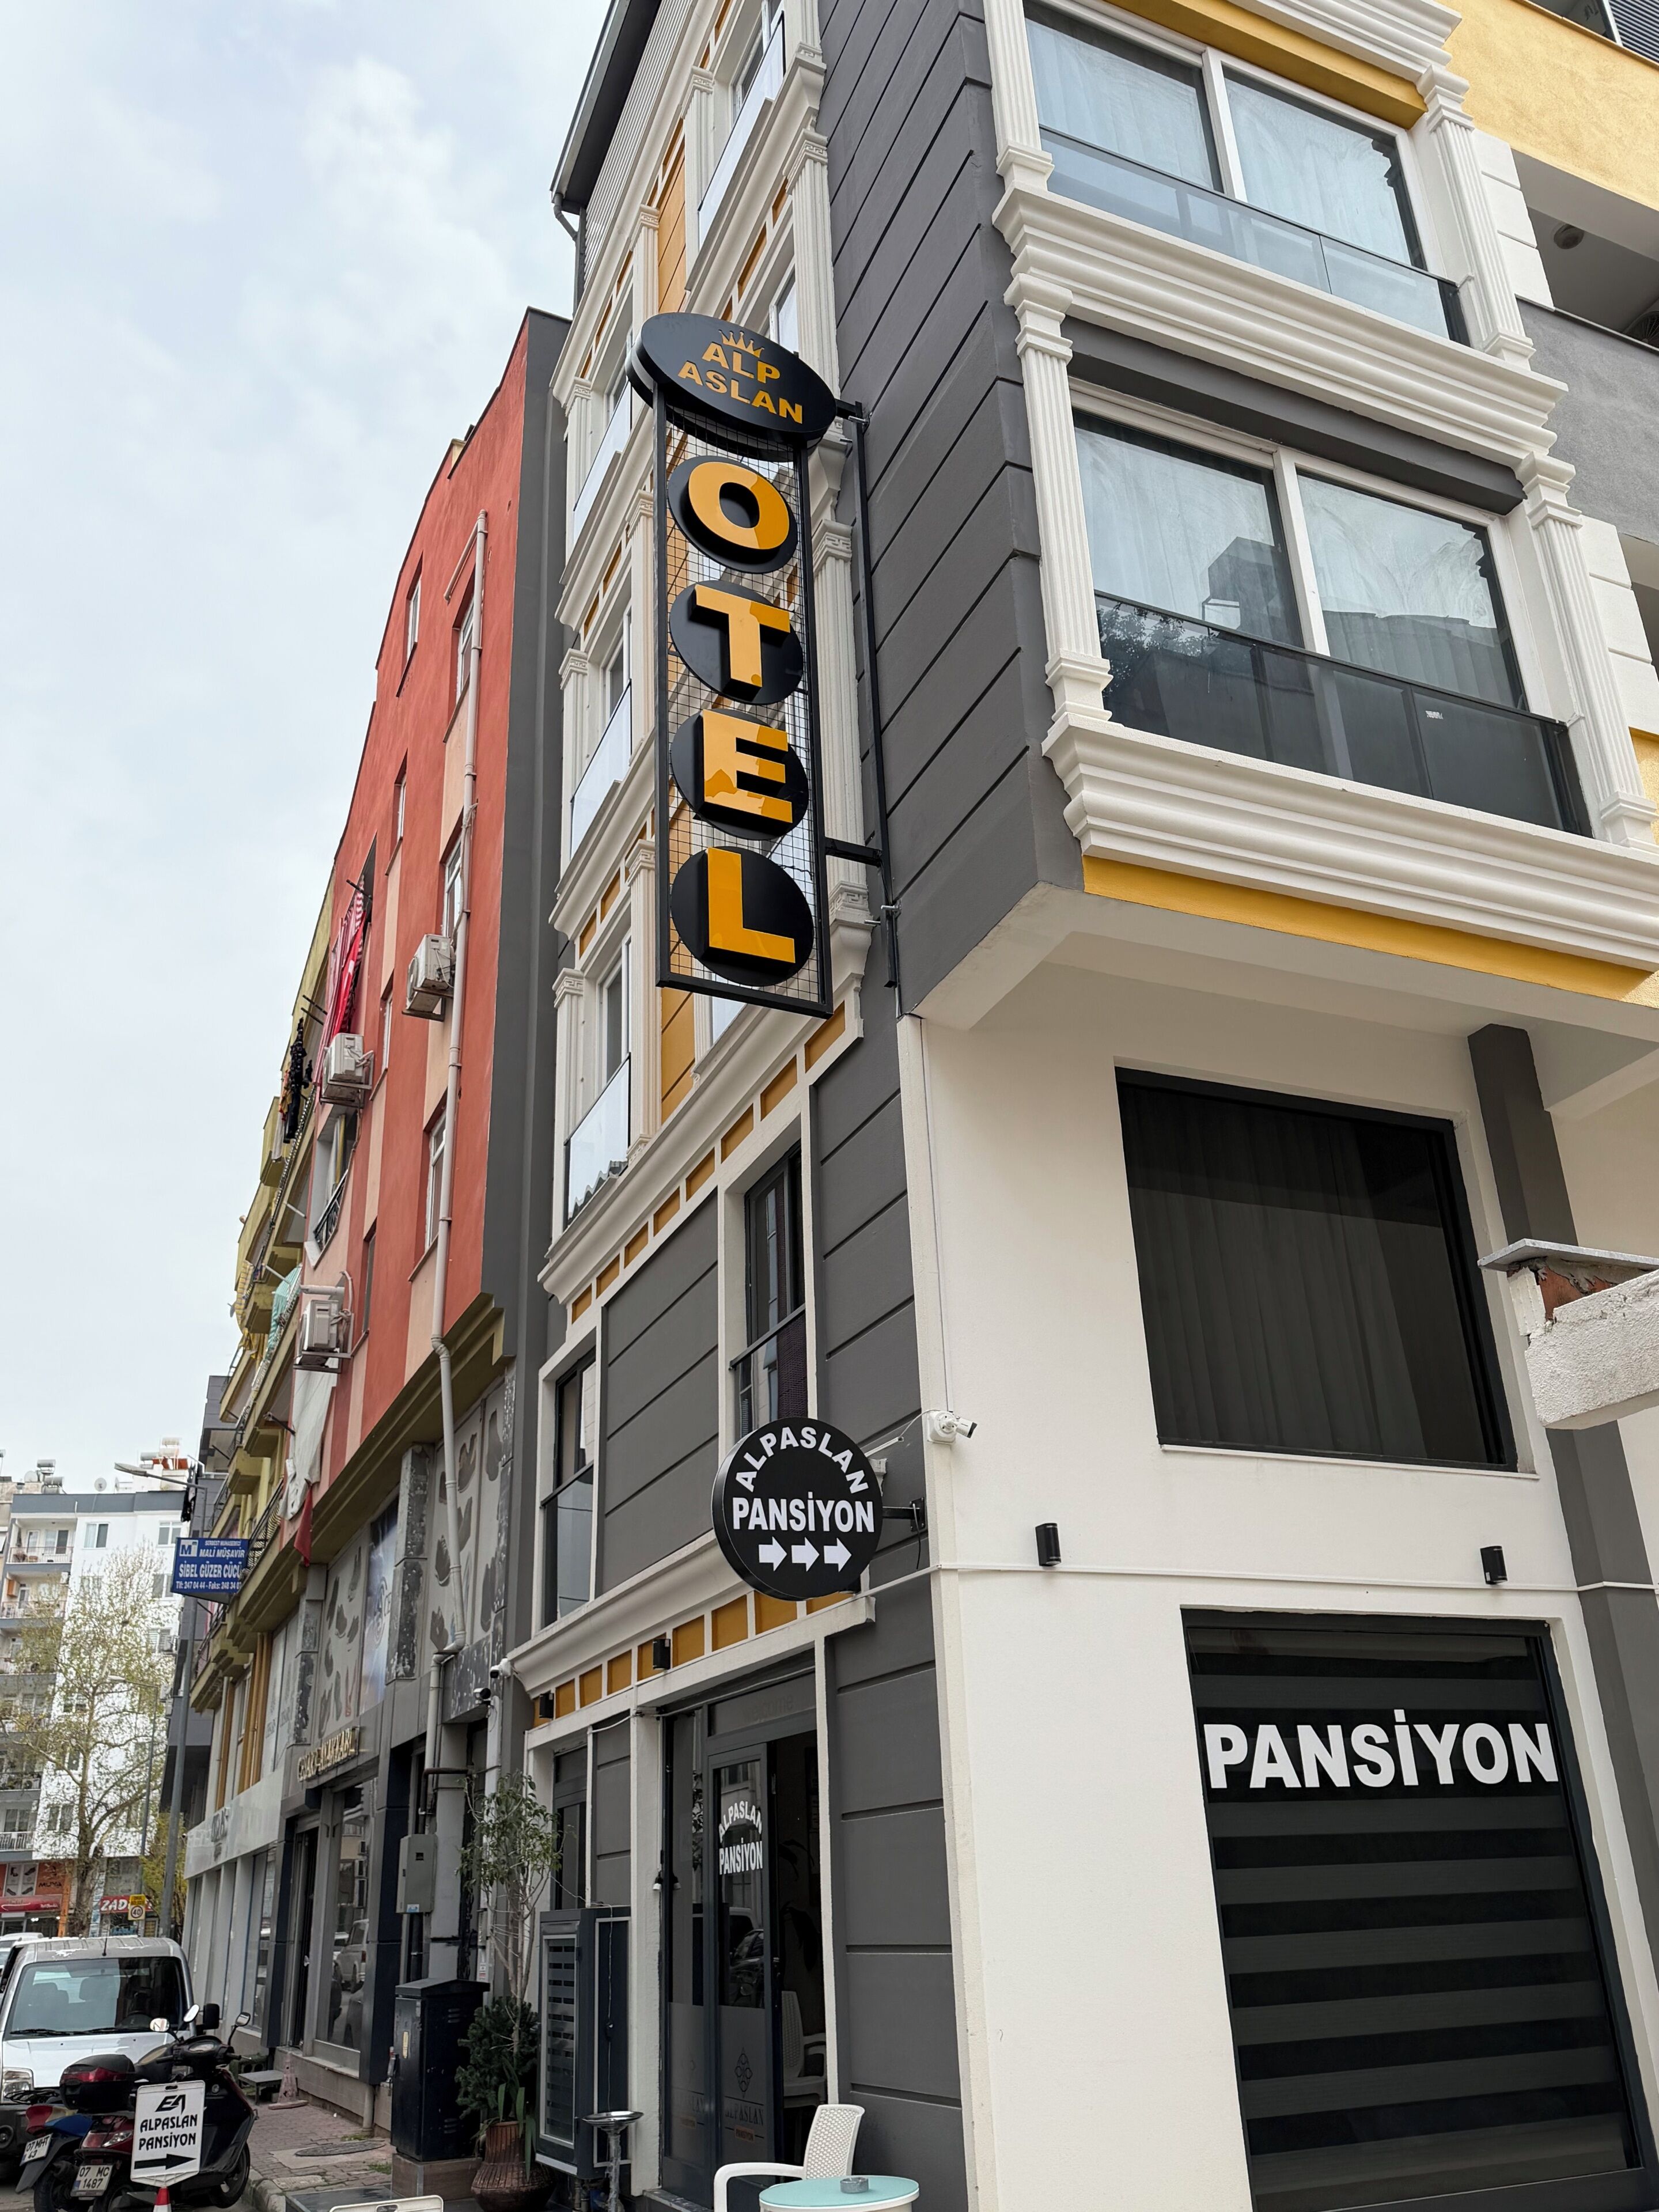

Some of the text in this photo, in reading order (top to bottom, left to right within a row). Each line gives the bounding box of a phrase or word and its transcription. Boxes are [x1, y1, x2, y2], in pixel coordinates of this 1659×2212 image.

[702, 341, 781, 384] ALP
[677, 361, 804, 425] ASLAN
[688, 461, 796, 964] OTEL
[735, 1426, 869, 1494] ALPASLAN
[732, 1491, 875, 1533] PANSİYON
[179, 1560, 198, 1578] SİBEL
[199, 1560, 222, 1578] GÜZER
[199, 1547, 245, 1559] MALİ MÜŞAVİR
[1203, 1709, 1559, 1789] PANSİYON
[718, 1801, 762, 1843] ALPASLAN
[719, 1838, 763, 1875] PANSİYON
[139, 2132, 196, 2151] PANSİYON
[140, 2114, 198, 2133] ALPASLAN
[26, 2141, 36, 2152] 07
[79, 2166, 109, 2177] 07 MC
[83, 2178, 103, 2188] 1487
